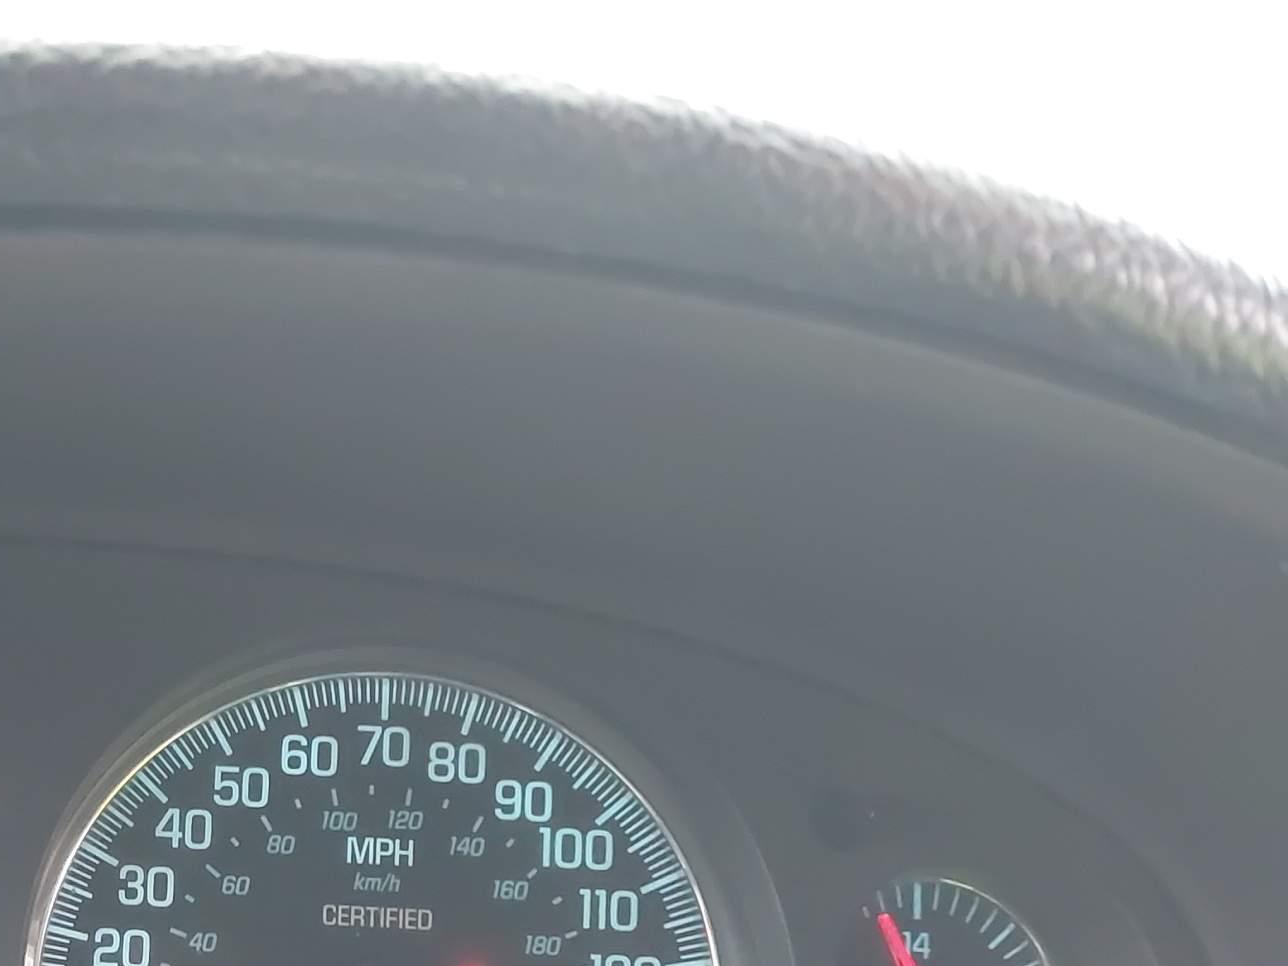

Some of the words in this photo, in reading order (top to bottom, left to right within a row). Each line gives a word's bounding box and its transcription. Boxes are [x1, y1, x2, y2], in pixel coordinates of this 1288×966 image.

[281, 735, 338, 776] 60
[357, 726, 410, 767] 70
[428, 743, 486, 784] 80
[213, 766, 269, 807] 50
[494, 781, 552, 822] 90
[155, 808, 212, 850] 40
[321, 812, 357, 831] 100
[387, 811, 423, 831] 120
[267, 836, 295, 855] 80
[346, 837, 414, 867] MPH
[449, 837, 485, 858] 140
[539, 827, 613, 870] 100
[118, 866, 174, 907] 30
[221, 876, 250, 896] 60
[354, 873, 400, 893] km/h
[492, 880, 528, 901] 160
[322, 905, 432, 931] CERTIFIED
[579, 889, 637, 931] 110
[188, 933, 217, 953] 40
[524, 935, 561, 956] 180
[902, 931, 931, 960] 14
